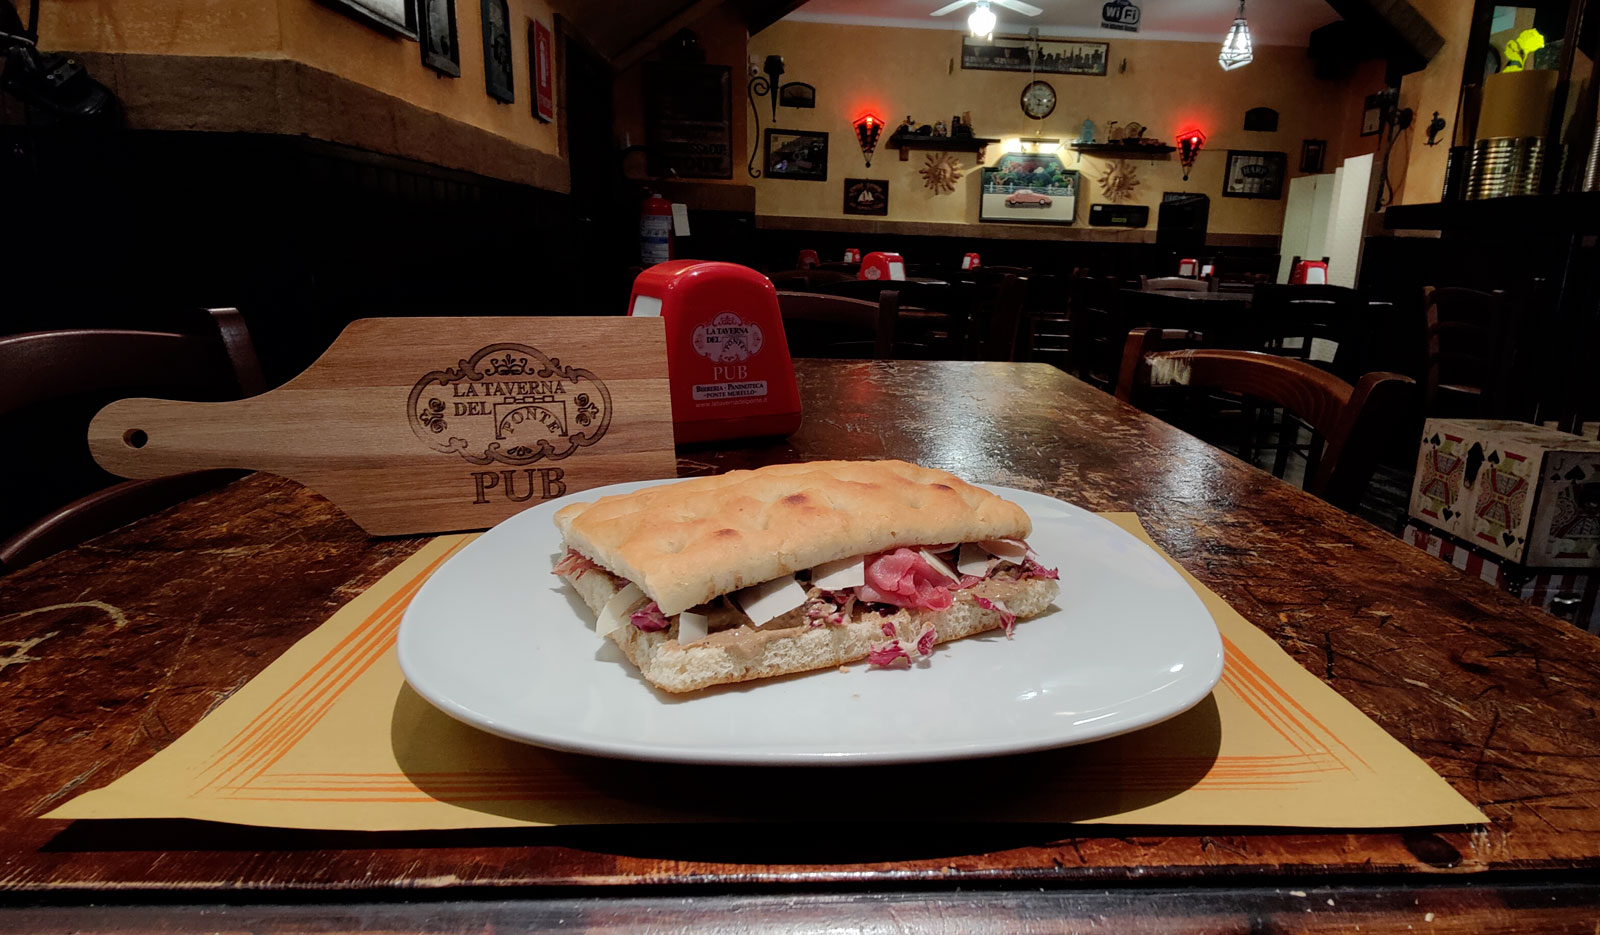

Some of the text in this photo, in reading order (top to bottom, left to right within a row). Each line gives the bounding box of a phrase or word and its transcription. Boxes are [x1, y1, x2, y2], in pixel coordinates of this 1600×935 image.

[717, 327, 749, 335] TAVERNA
[706, 336, 747, 350] DEL PONTE
[713, 365, 748, 381] PUB
[453, 380, 567, 397] LA TAVERNA
[454, 402, 561, 434] DEL PONTE
[470, 467, 567, 505] PUB
